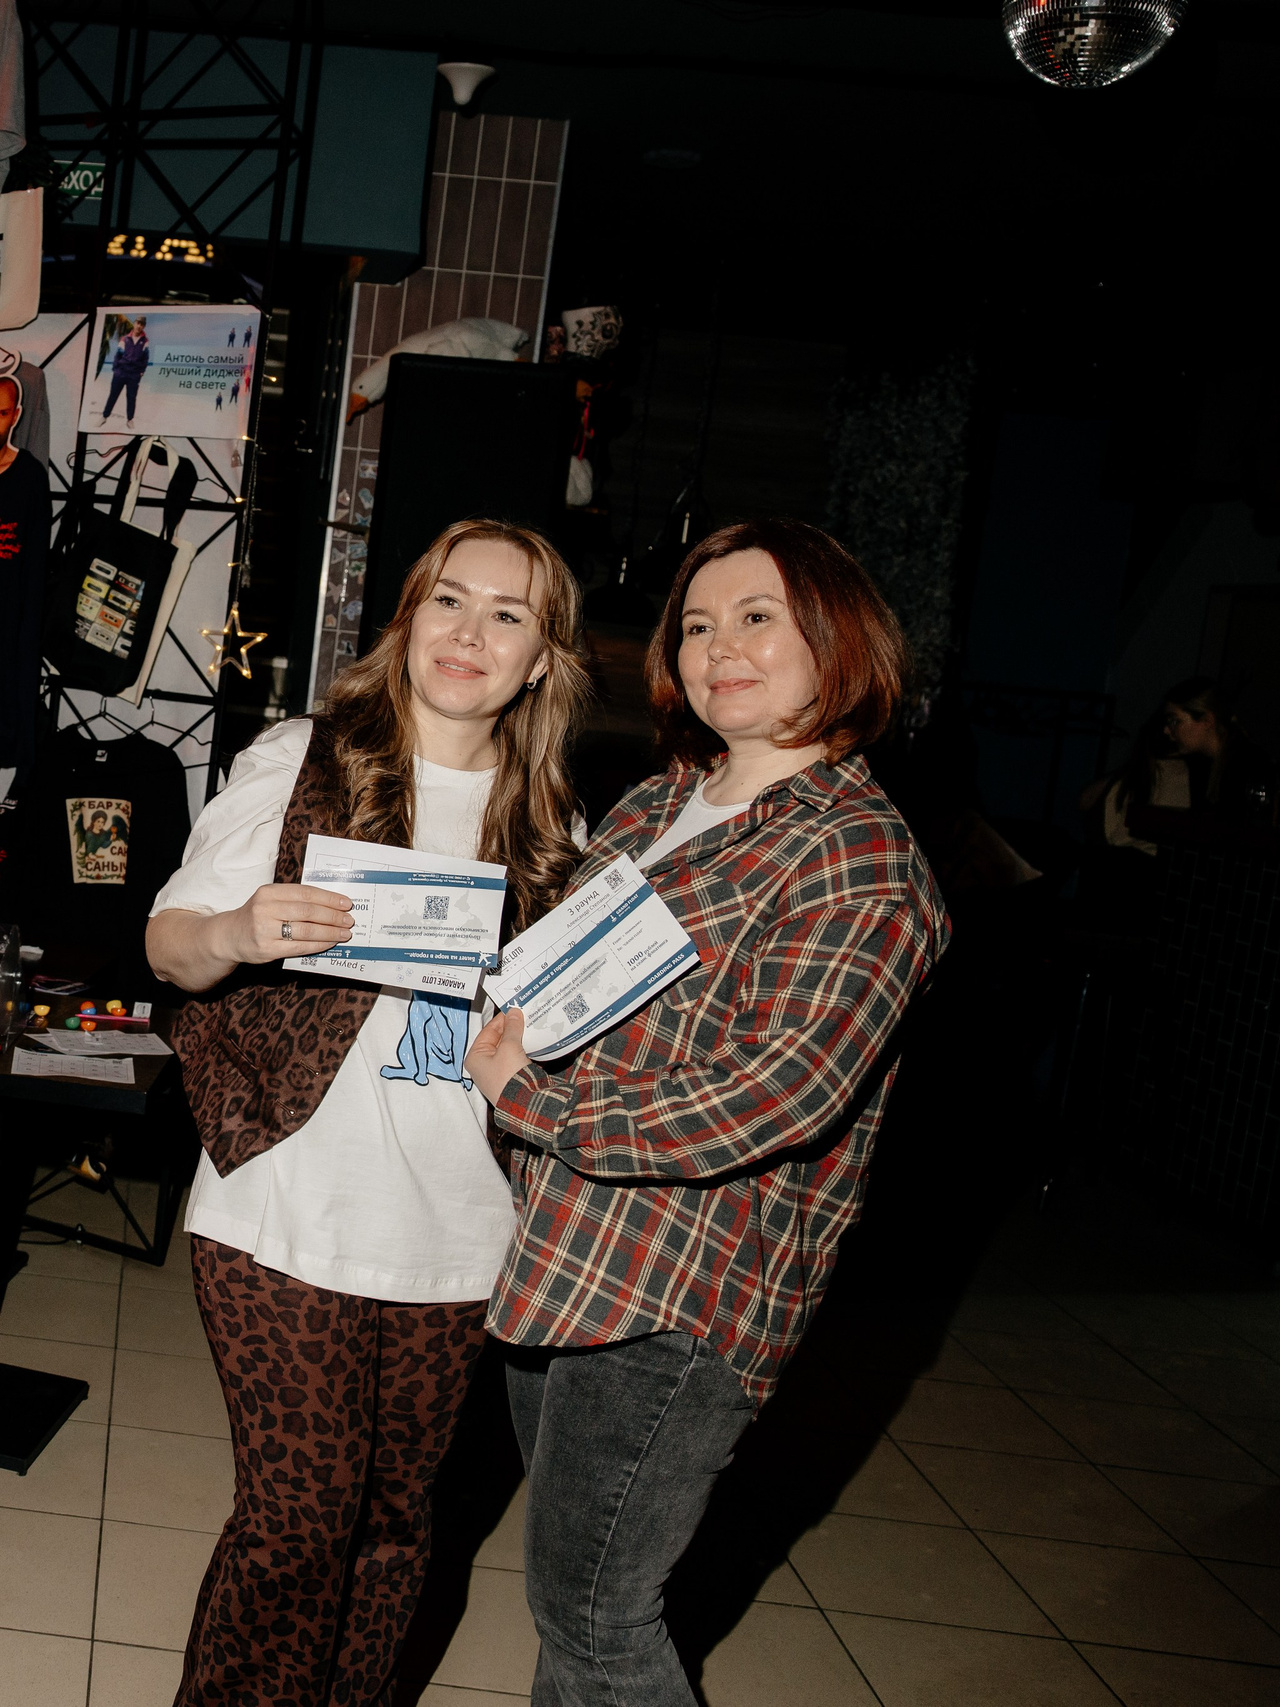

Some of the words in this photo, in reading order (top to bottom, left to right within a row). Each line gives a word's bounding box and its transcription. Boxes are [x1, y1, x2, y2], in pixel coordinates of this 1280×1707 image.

[164, 352, 205, 364] Антонь
[207, 353, 244, 364] самый
[158, 366, 202, 377] лучший
[203, 366, 246, 378] диджей
[179, 380, 193, 389] на
[195, 381, 226, 390] свете
[88, 801, 113, 810] БАР
[567, 908, 575, 916] 3
[573, 889, 600, 912] раунд
[566, 908, 591, 929] Александр
[508, 946, 524, 961] LOTO
[627, 951, 644, 967] 1000
[330, 957, 358, 970] раунд
[647, 962, 673, 985] BOARDING
[671, 952, 685, 965] PASS
[421, 975, 437, 985] LOTO
[438, 977, 466, 990] KARAOKE
[519, 988, 533, 1002] Билет
[532, 983, 540, 991] на
[538, 974, 552, 987] море
